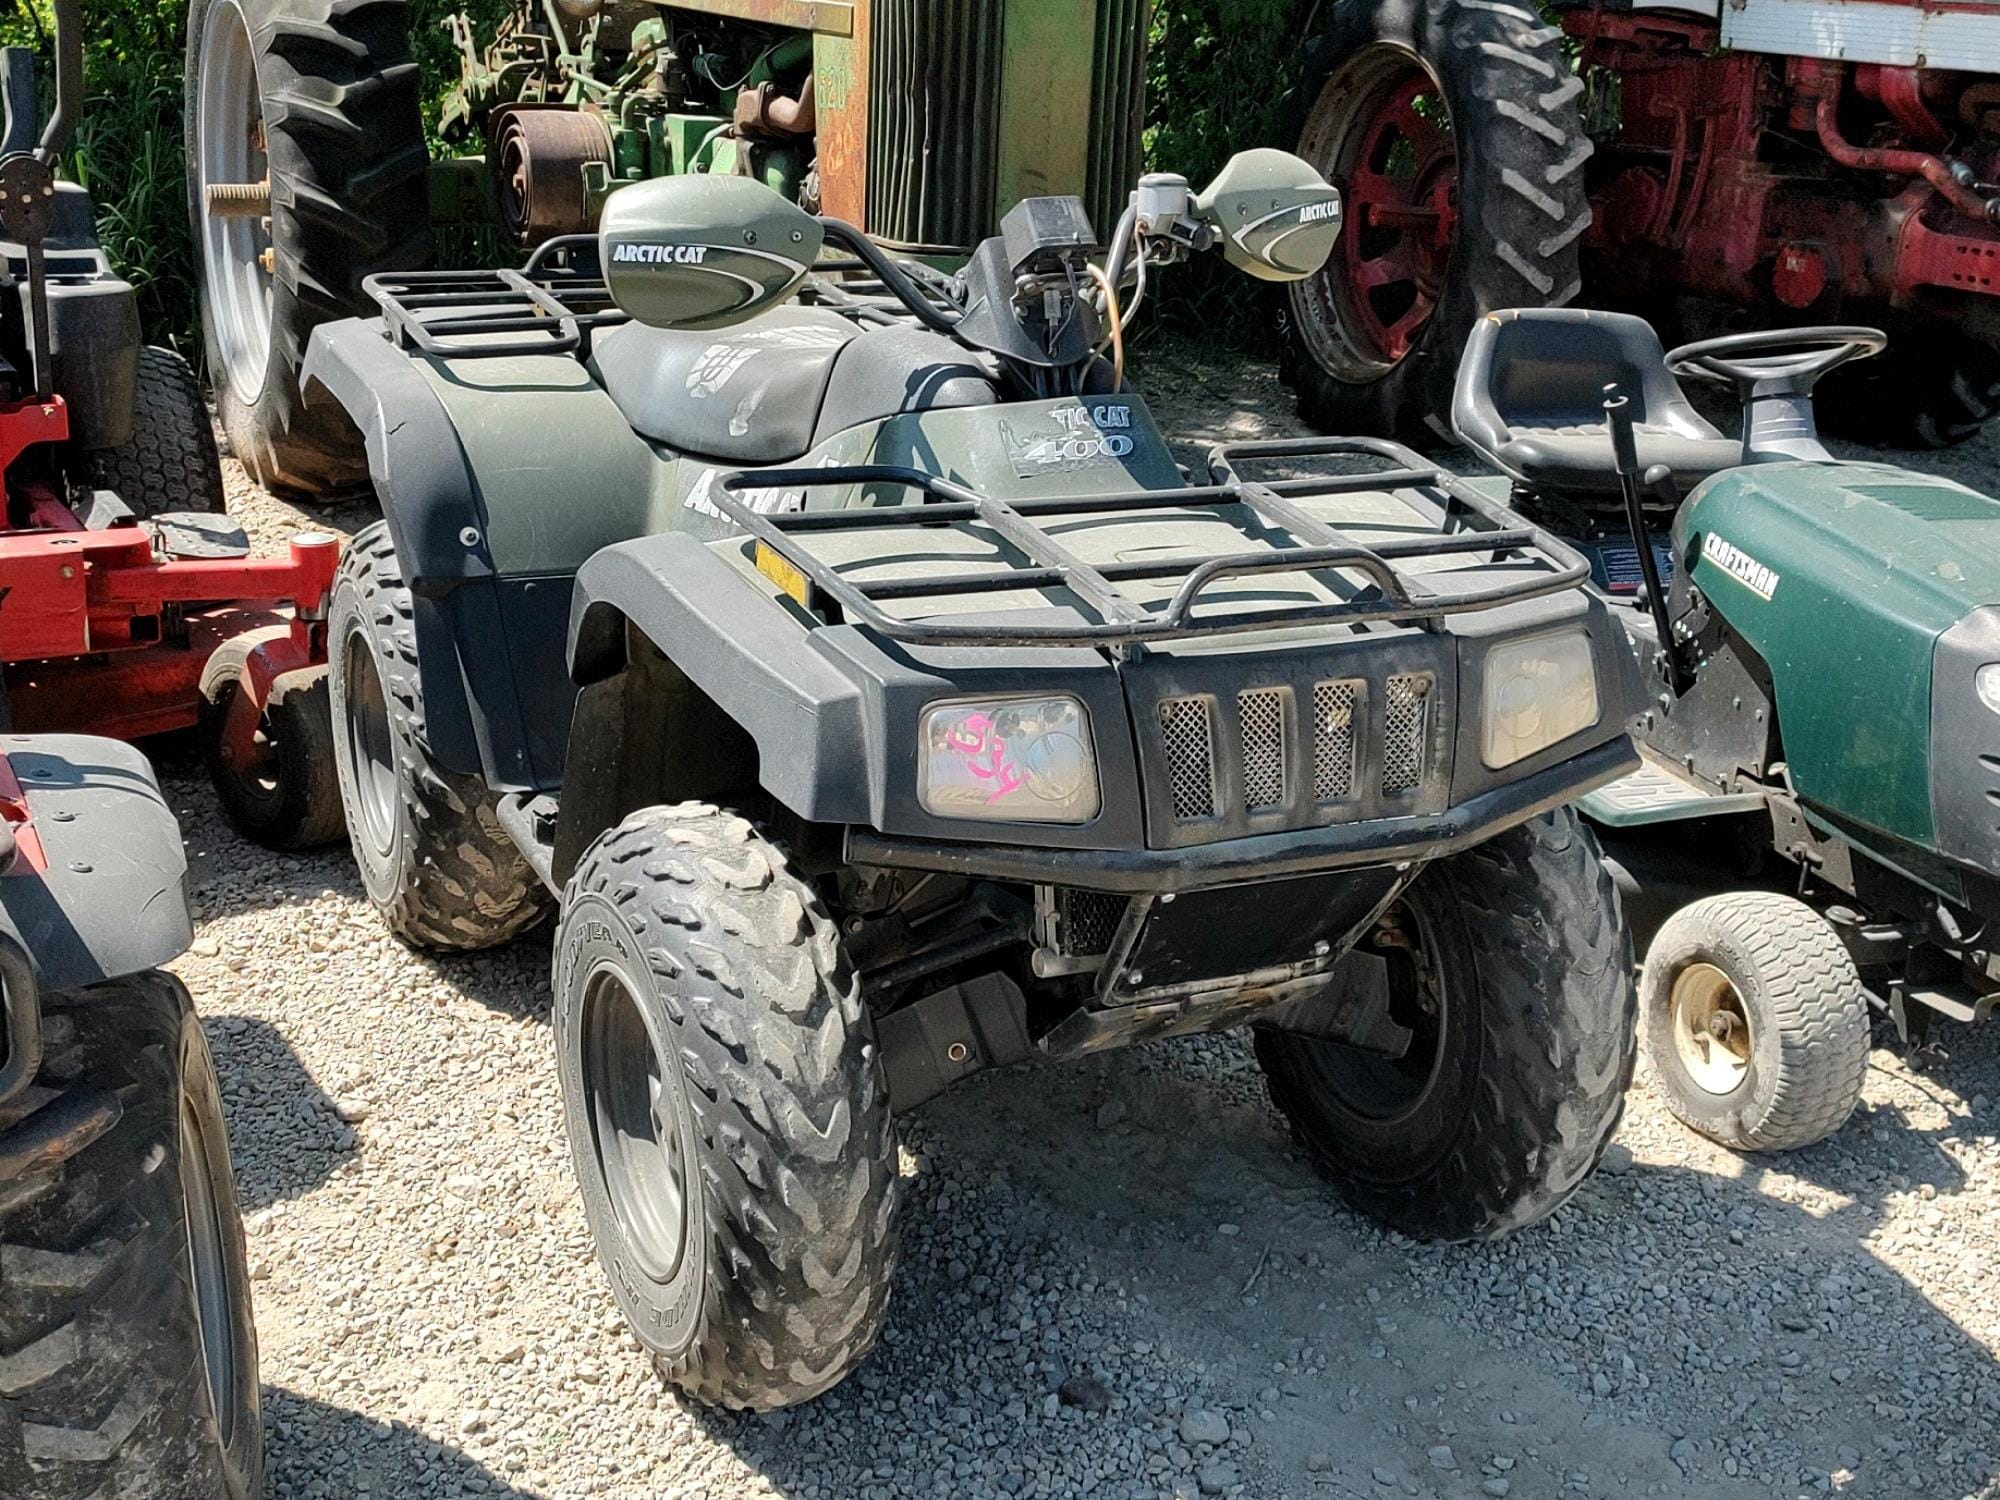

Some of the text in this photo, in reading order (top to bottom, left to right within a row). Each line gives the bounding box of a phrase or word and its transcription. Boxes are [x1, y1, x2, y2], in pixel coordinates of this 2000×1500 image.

[613, 244, 707, 264] ARCTIC CAT
[1093, 406, 1131, 428] CAT
[1023, 434, 1134, 464] 400
[1703, 531, 1781, 597] CRAFTSMAN
